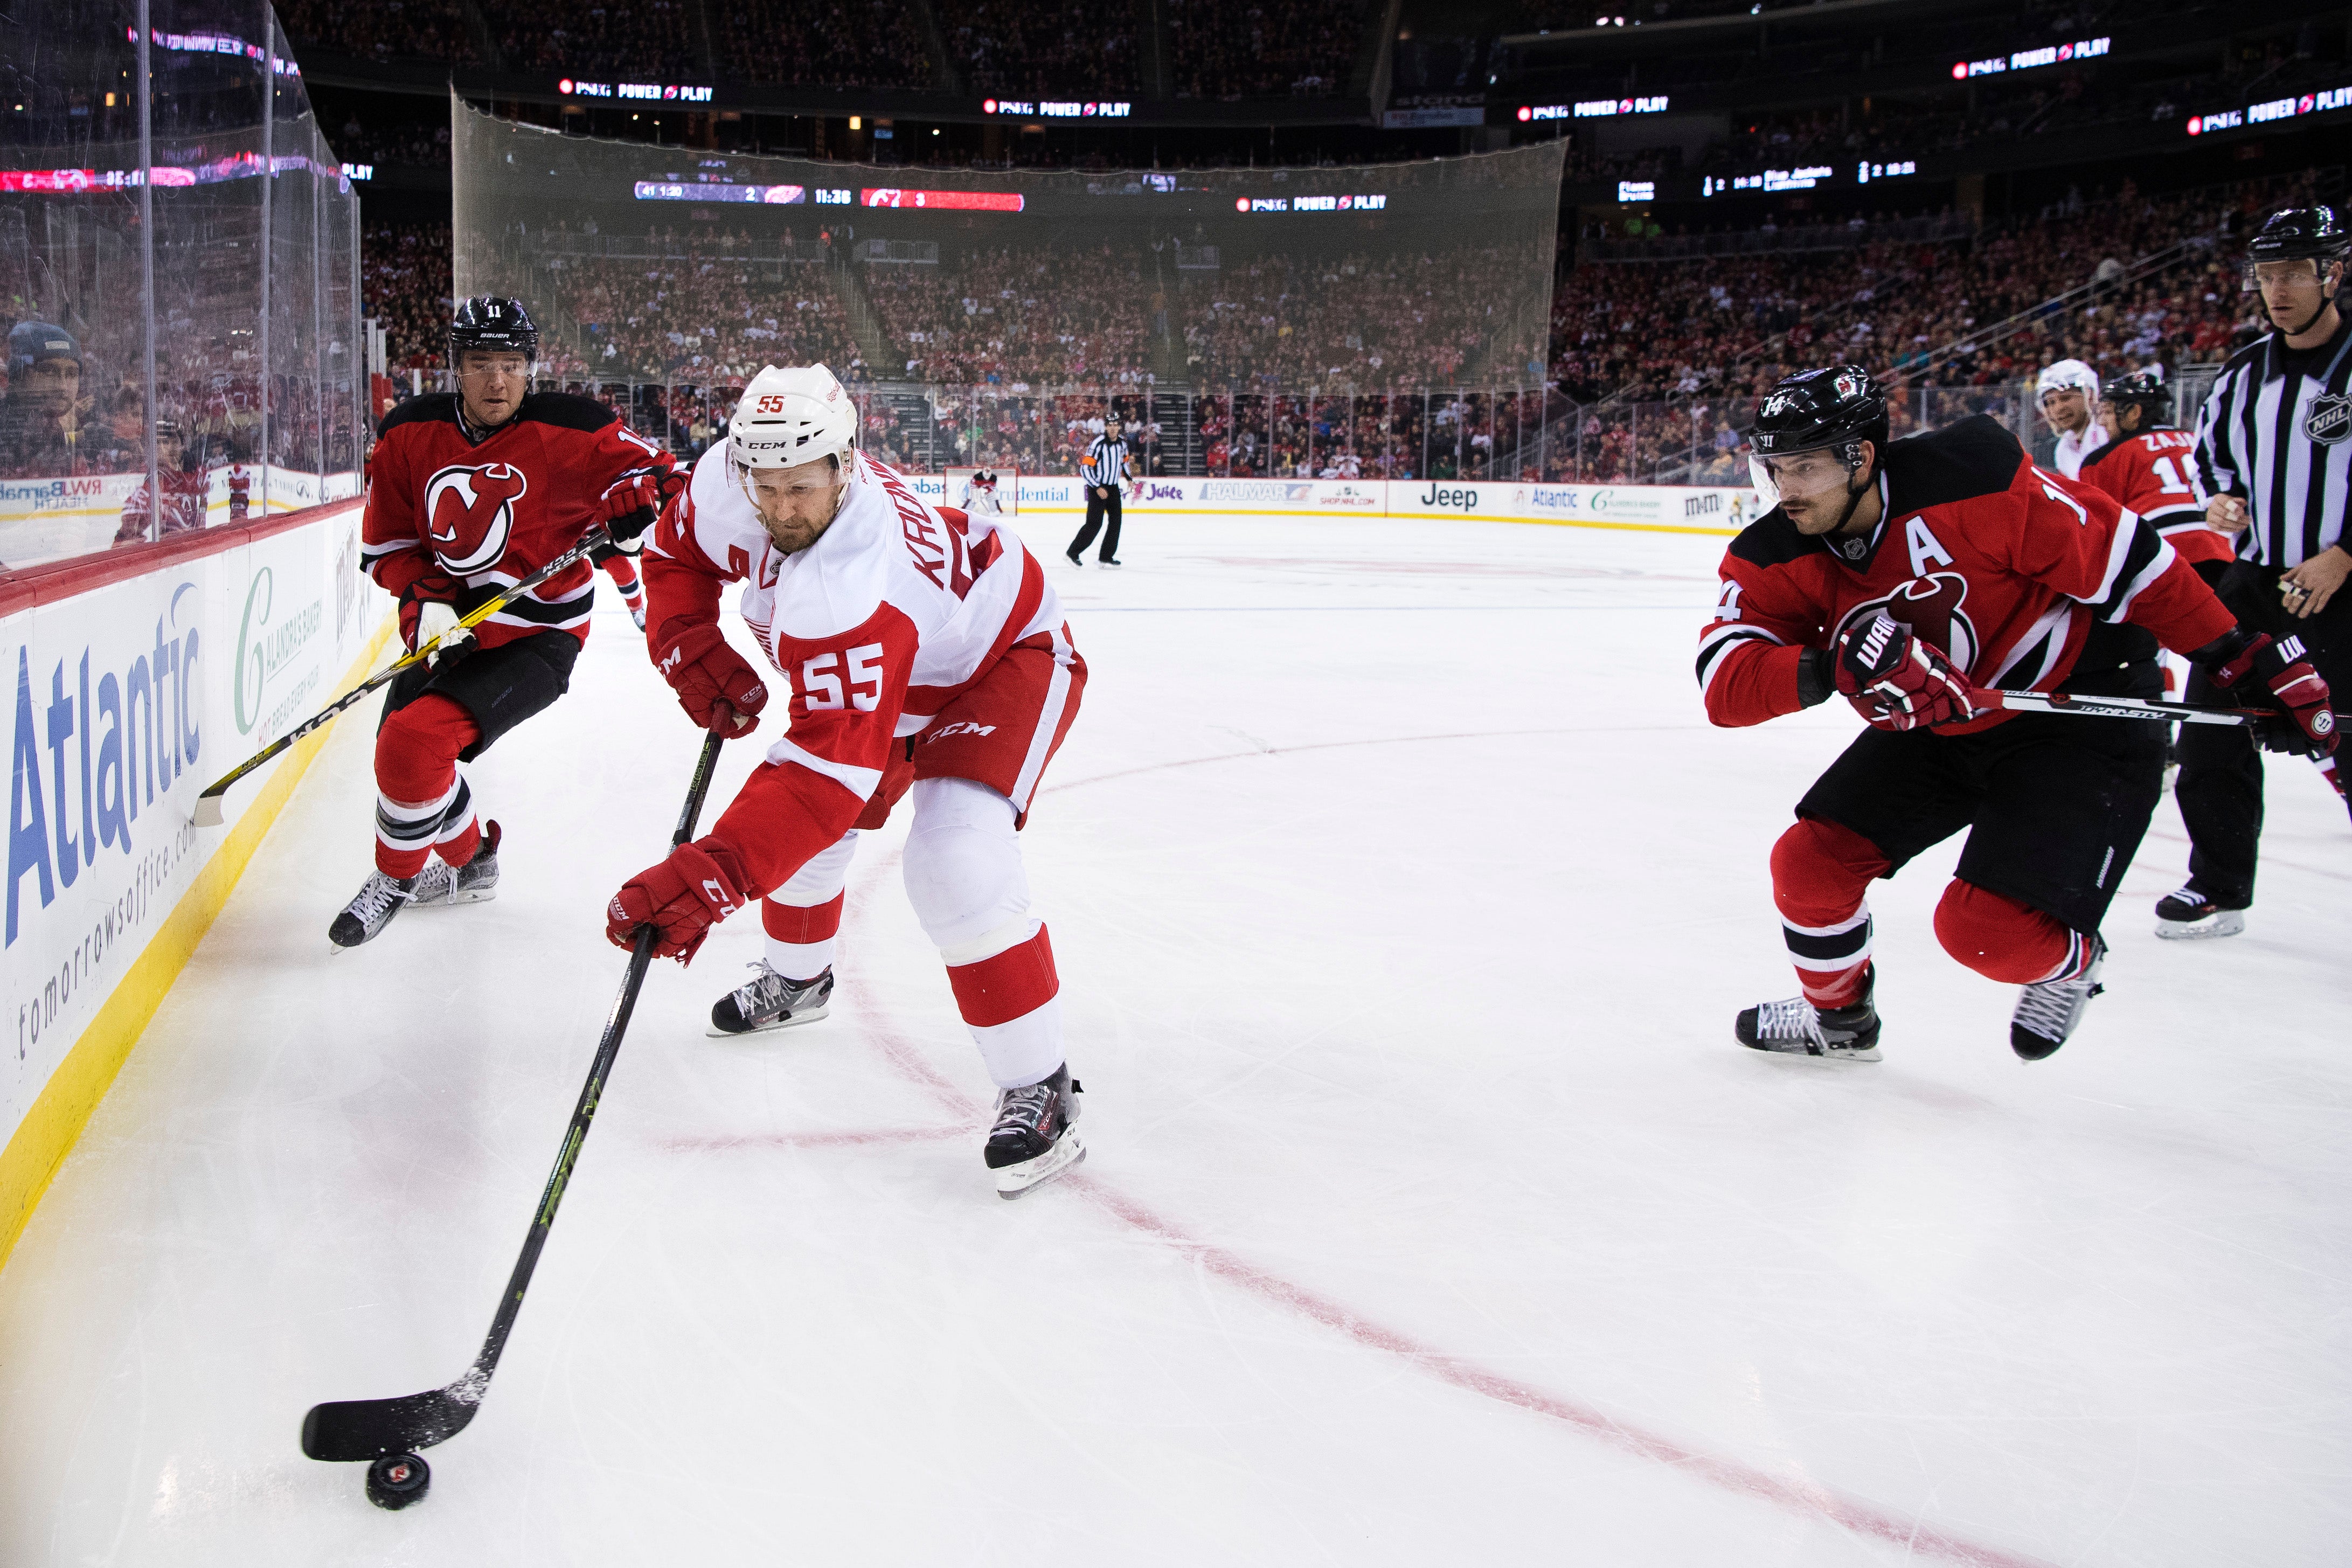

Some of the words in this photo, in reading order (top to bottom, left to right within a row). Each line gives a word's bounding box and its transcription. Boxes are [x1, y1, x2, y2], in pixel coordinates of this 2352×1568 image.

[2011, 47, 2056, 70] POWER
[2074, 37, 2110, 58] PLAY
[619, 84, 662, 99] POWER
[681, 86, 713, 101] PLAY
[1040, 102, 1081, 116] POWER
[1099, 102, 1130, 116] PLAY
[1574, 100, 1617, 117] POWER
[1635, 96, 1668, 113] PLAY
[2247, 98, 2297, 124] POWER
[745, 186, 755, 202] 2
[915, 192, 926, 207] 3
[1294, 196, 1336, 211] POWER
[1354, 195, 1386, 209] PLAY
[488, 305, 501, 318] 11
[757, 396, 786, 413] 55
[1762, 396, 1785, 418] 14
[2313, 408, 2347, 432] NHL
[748, 441, 786, 449] CCM
[1146, 484, 1183, 501] Juice
[1205, 483, 1286, 501] HALMAR
[1421, 482, 1478, 511] Jeep
[1531, 487, 1578, 508] Atlantic
[1905, 515, 1954, 578] A
[803, 642, 884, 712] 55
[258, 717, 271, 753] HOT
[272, 696, 289, 737] BREAD
[927, 721, 997, 744] CCM
[5, 582, 201, 951] Atlantic
[19, 816, 197, 1061] tomorrowsoffice.com
